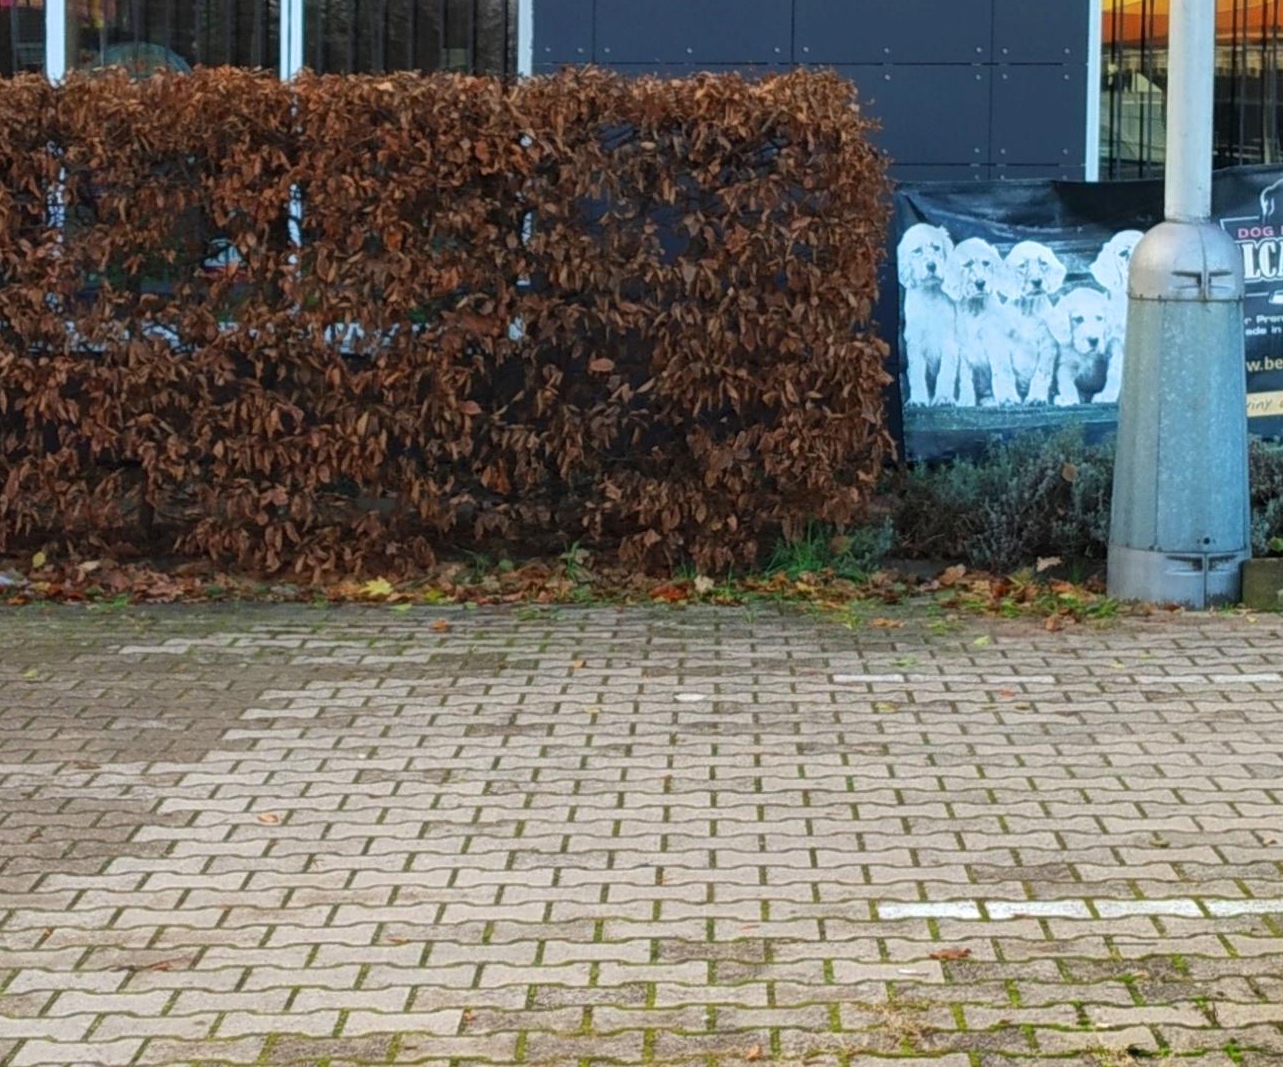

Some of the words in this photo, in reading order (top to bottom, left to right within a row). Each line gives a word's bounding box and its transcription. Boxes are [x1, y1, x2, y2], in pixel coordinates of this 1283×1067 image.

[1237, 226, 1274, 239] DOG
[1245, 326, 1267, 336] ade
[1271, 325, 1282, 334] in
